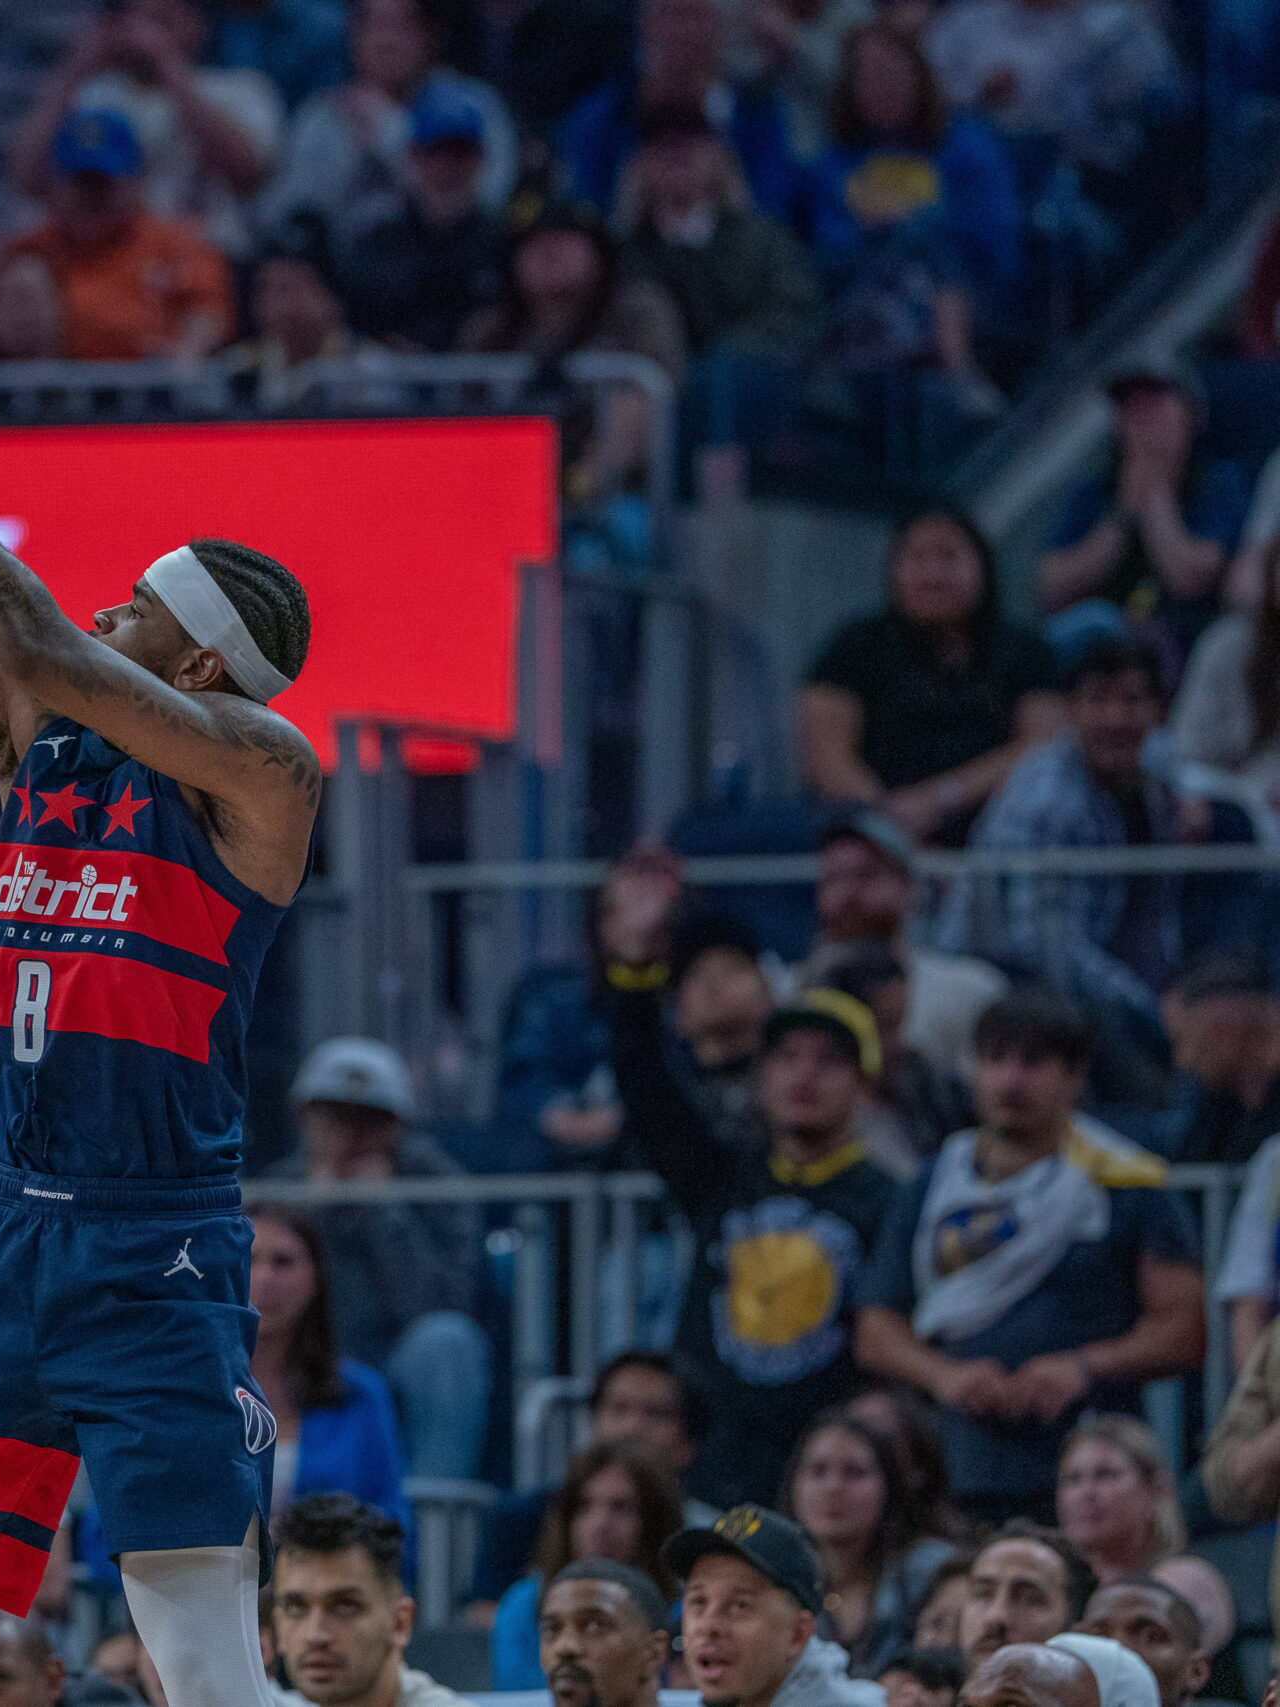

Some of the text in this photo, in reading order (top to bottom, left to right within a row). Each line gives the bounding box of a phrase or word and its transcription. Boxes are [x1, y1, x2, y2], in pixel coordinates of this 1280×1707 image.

[24, 861, 37, 875] THE
[4, 927, 125, 949] OLUMBIA
[12, 958, 52, 1062] 8
[23, 1187, 73, 1200] WASHINGTON
